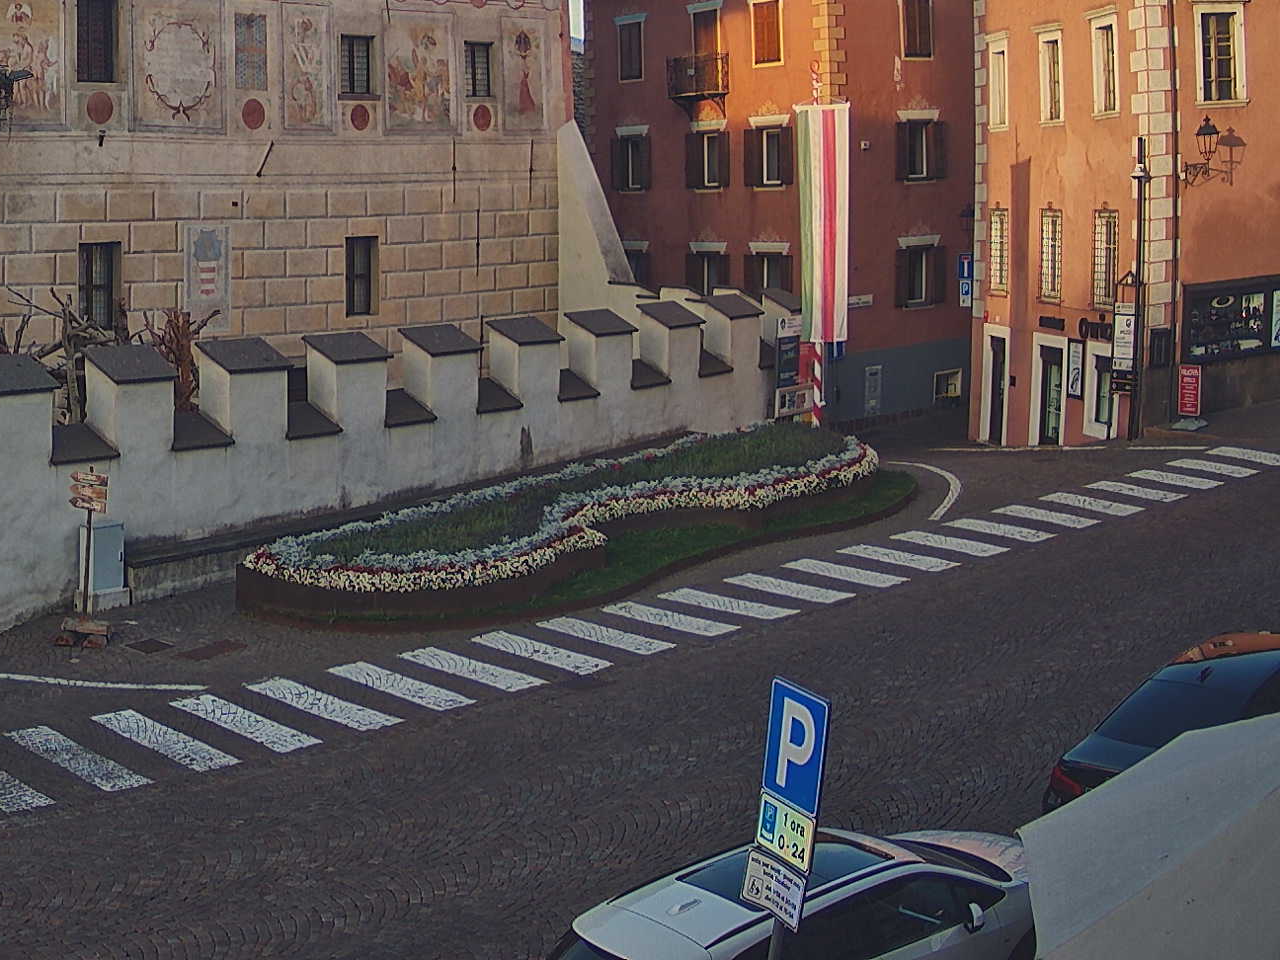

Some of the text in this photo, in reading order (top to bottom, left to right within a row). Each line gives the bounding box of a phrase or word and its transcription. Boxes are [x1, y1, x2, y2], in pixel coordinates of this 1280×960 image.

[776, 696, 815, 788] P
[783, 813, 805, 838] 1 ora
